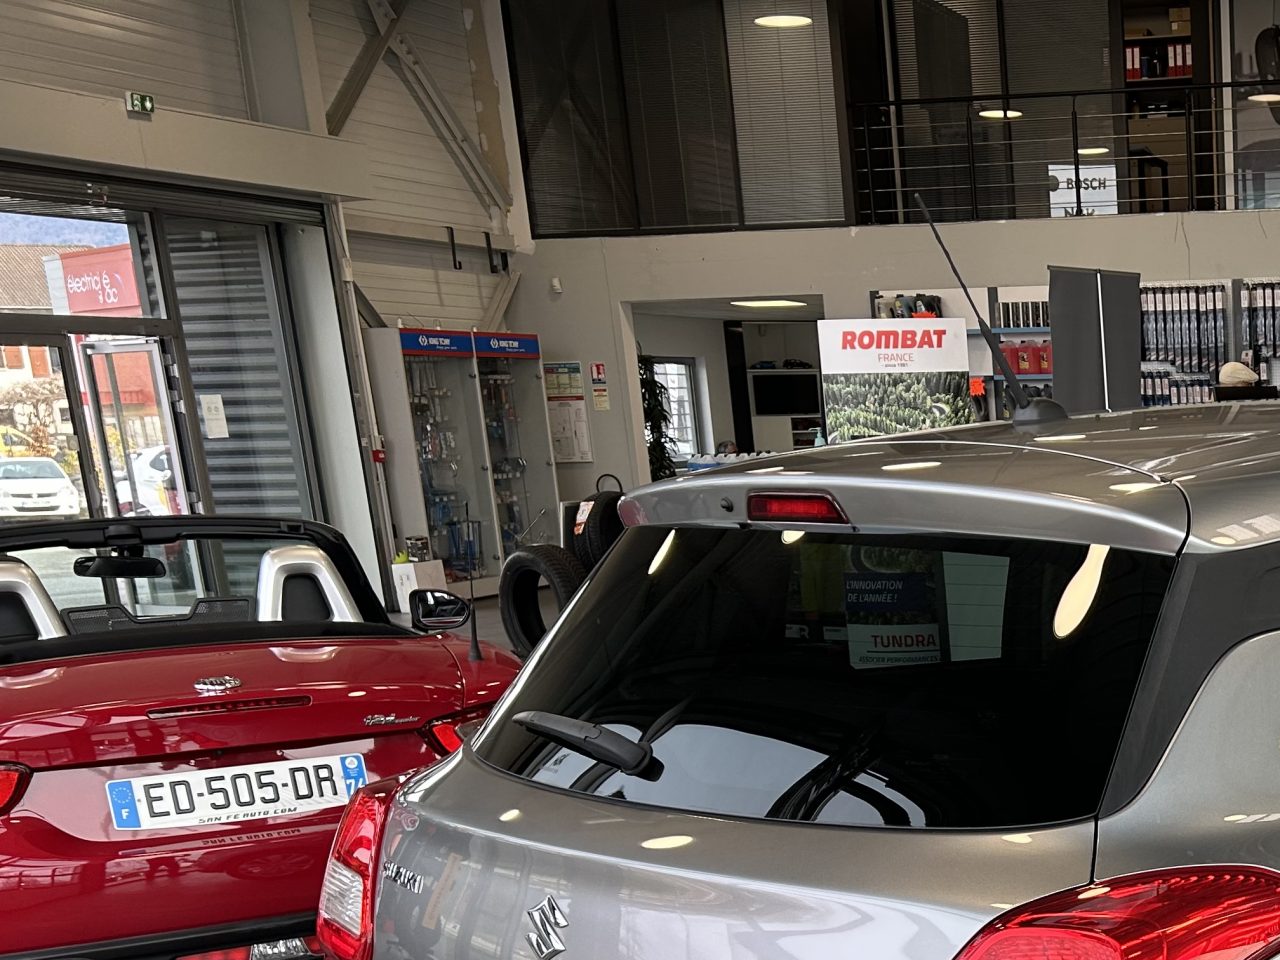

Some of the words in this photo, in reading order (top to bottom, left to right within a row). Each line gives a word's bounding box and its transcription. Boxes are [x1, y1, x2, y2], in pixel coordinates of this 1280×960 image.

[1066, 178, 1106, 190] BSCH
[841, 329, 947, 350] ROMBAT
[878, 353, 915, 362] FRANCE
[846, 580, 903, 590] L'INNOVATION
[871, 634, 937, 649] TUNDRA
[143, 764, 338, 818] ED-505-DR
[121, 809, 130, 820] F
